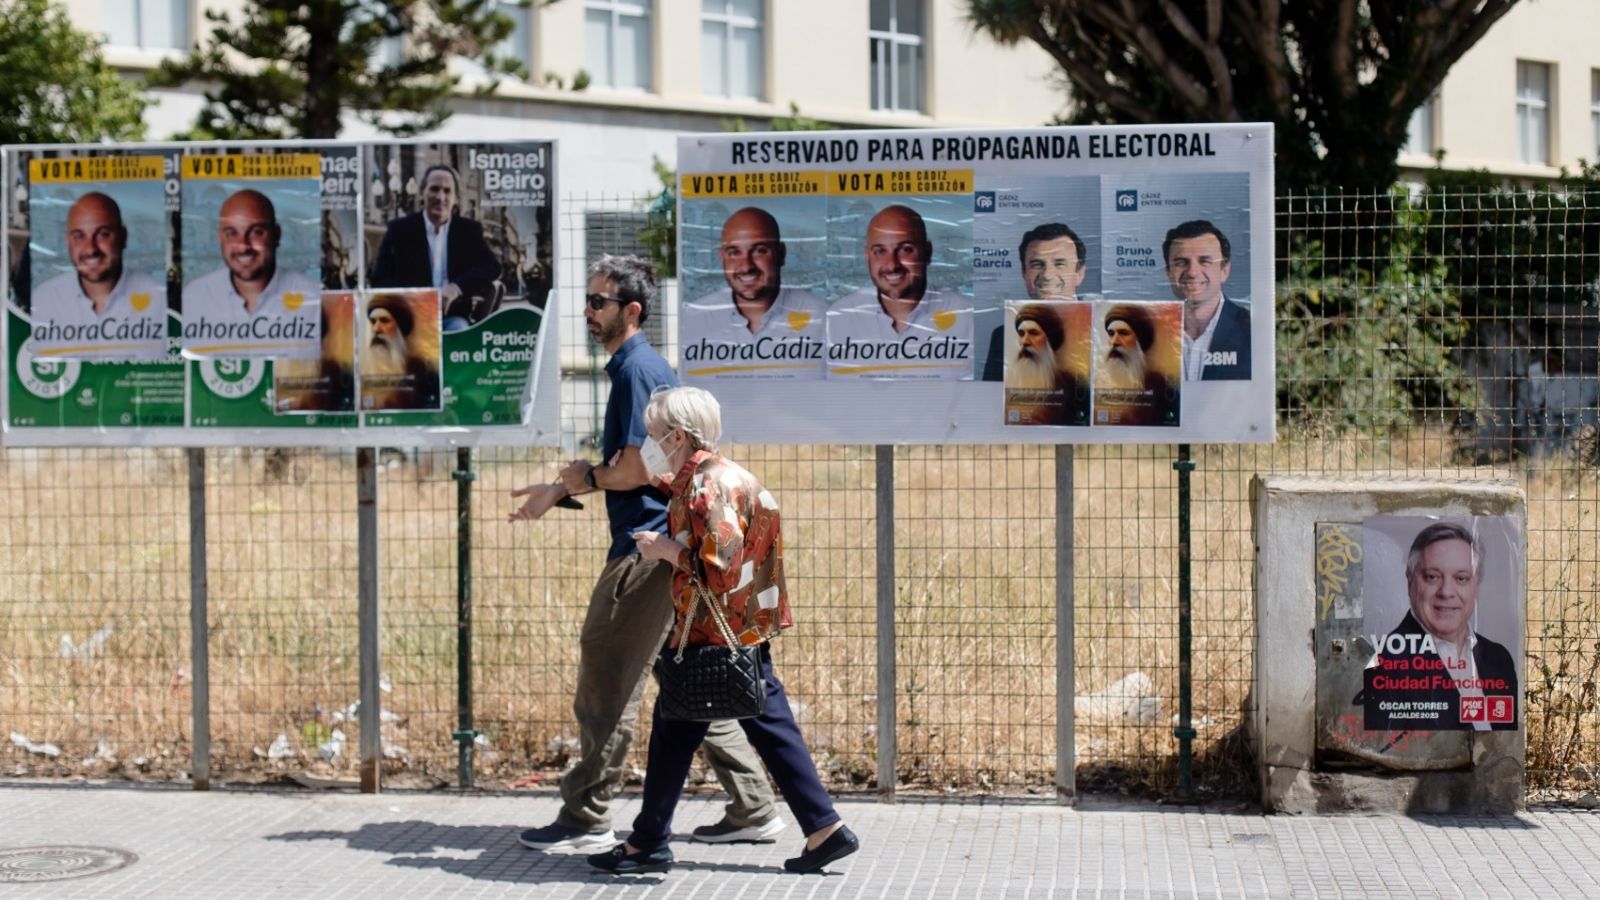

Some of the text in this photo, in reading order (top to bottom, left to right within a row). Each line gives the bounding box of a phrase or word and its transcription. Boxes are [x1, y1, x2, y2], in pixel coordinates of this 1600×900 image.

[732, 133, 1216, 164] RESERVADO PARA PROPAGANDA ELECTORAL
[192, 157, 235, 175] VOTA
[469, 148, 545, 169] Ismael
[41, 161, 82, 178] VOTA
[891, 171, 911, 181] POR
[484, 169, 545, 190] Beiro
[693, 176, 738, 194] VOTA
[745, 173, 764, 183] POR
[838, 173, 884, 191] VOTA
[891, 179, 966, 192] CON CORAZÓN
[745, 184, 764, 194] CON
[973, 247, 1009, 256] Bruno
[1116, 246, 1152, 255] Bruno
[973, 258, 1013, 268] García
[1116, 256, 1156, 267] García
[34, 316, 163, 340] ahoraCádiz
[185, 315, 316, 340] ahoraCádiz
[482, 331, 539, 347] Particip
[450, 350, 470, 362] en
[473, 347, 487, 362] el
[685, 336, 823, 361] ahoraCádiz
[829, 336, 970, 360] ahoraCádiz
[1203, 351, 1237, 366] 28M
[1371, 633, 1437, 655] VOTA
[1374, 656, 1467, 671] Para Que La
[1372, 675, 1510, 690] Ciudad Funcione.
[1379, 701, 1449, 711] ÓSCAR TORRES
[1462, 701, 1483, 709] PSOE
